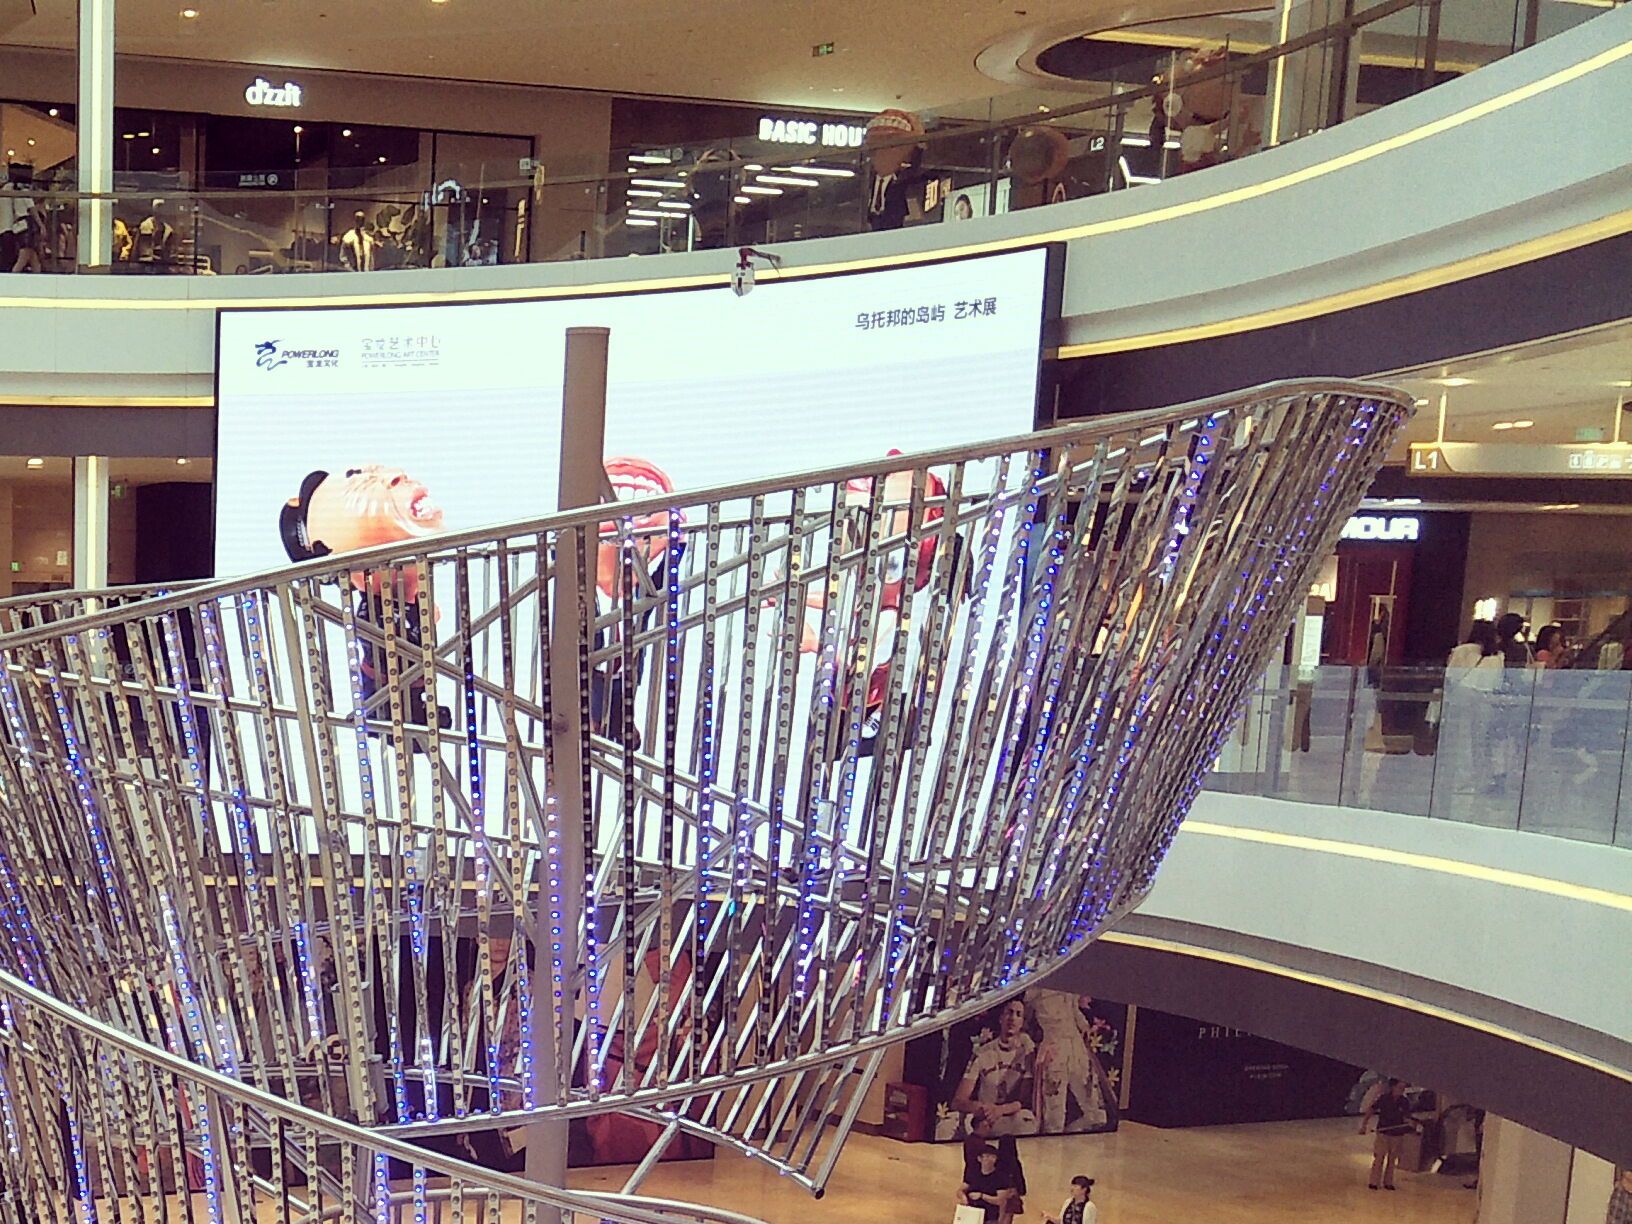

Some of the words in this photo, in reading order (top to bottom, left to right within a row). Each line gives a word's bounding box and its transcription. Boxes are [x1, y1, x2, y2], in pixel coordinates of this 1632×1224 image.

[759, 118, 817, 145] BASIC
[821, 124, 867, 147] HOU
[1090, 136, 1104, 151] L2
[855, 303, 946, 331] 乌托邦的岛屿
[953, 296, 998, 320] 艺术展
[281, 350, 339, 359] POWERLONG
[1413, 451, 1439, 470] L1
[1198, 1026, 1242, 1039] PHIL
